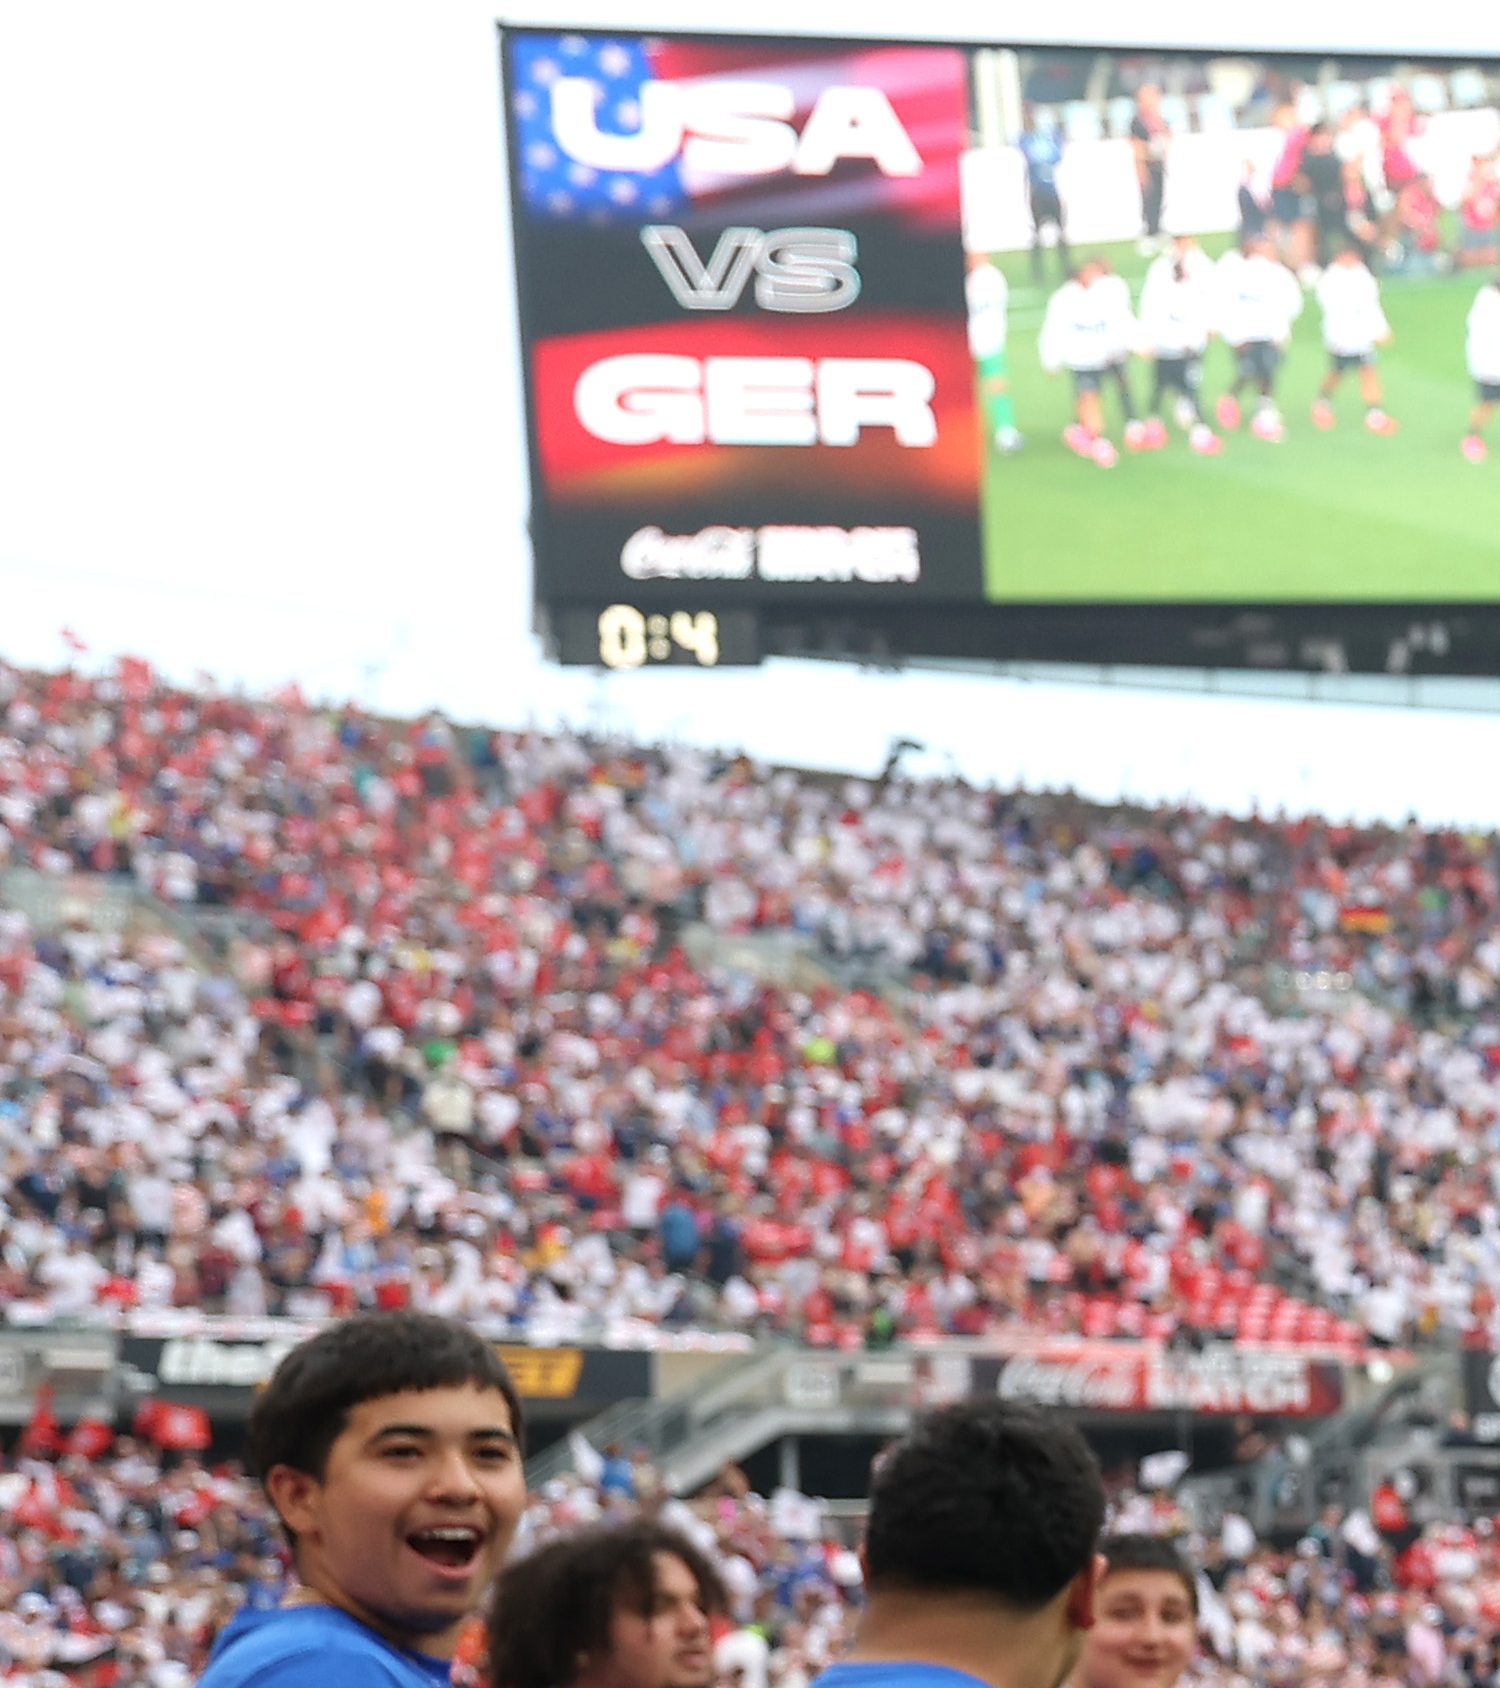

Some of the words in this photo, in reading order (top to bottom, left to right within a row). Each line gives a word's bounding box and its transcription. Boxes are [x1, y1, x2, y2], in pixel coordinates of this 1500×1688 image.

[552, 77, 923, 176] USA
[640, 225, 861, 312] VS
[574, 354, 937, 447] GER
